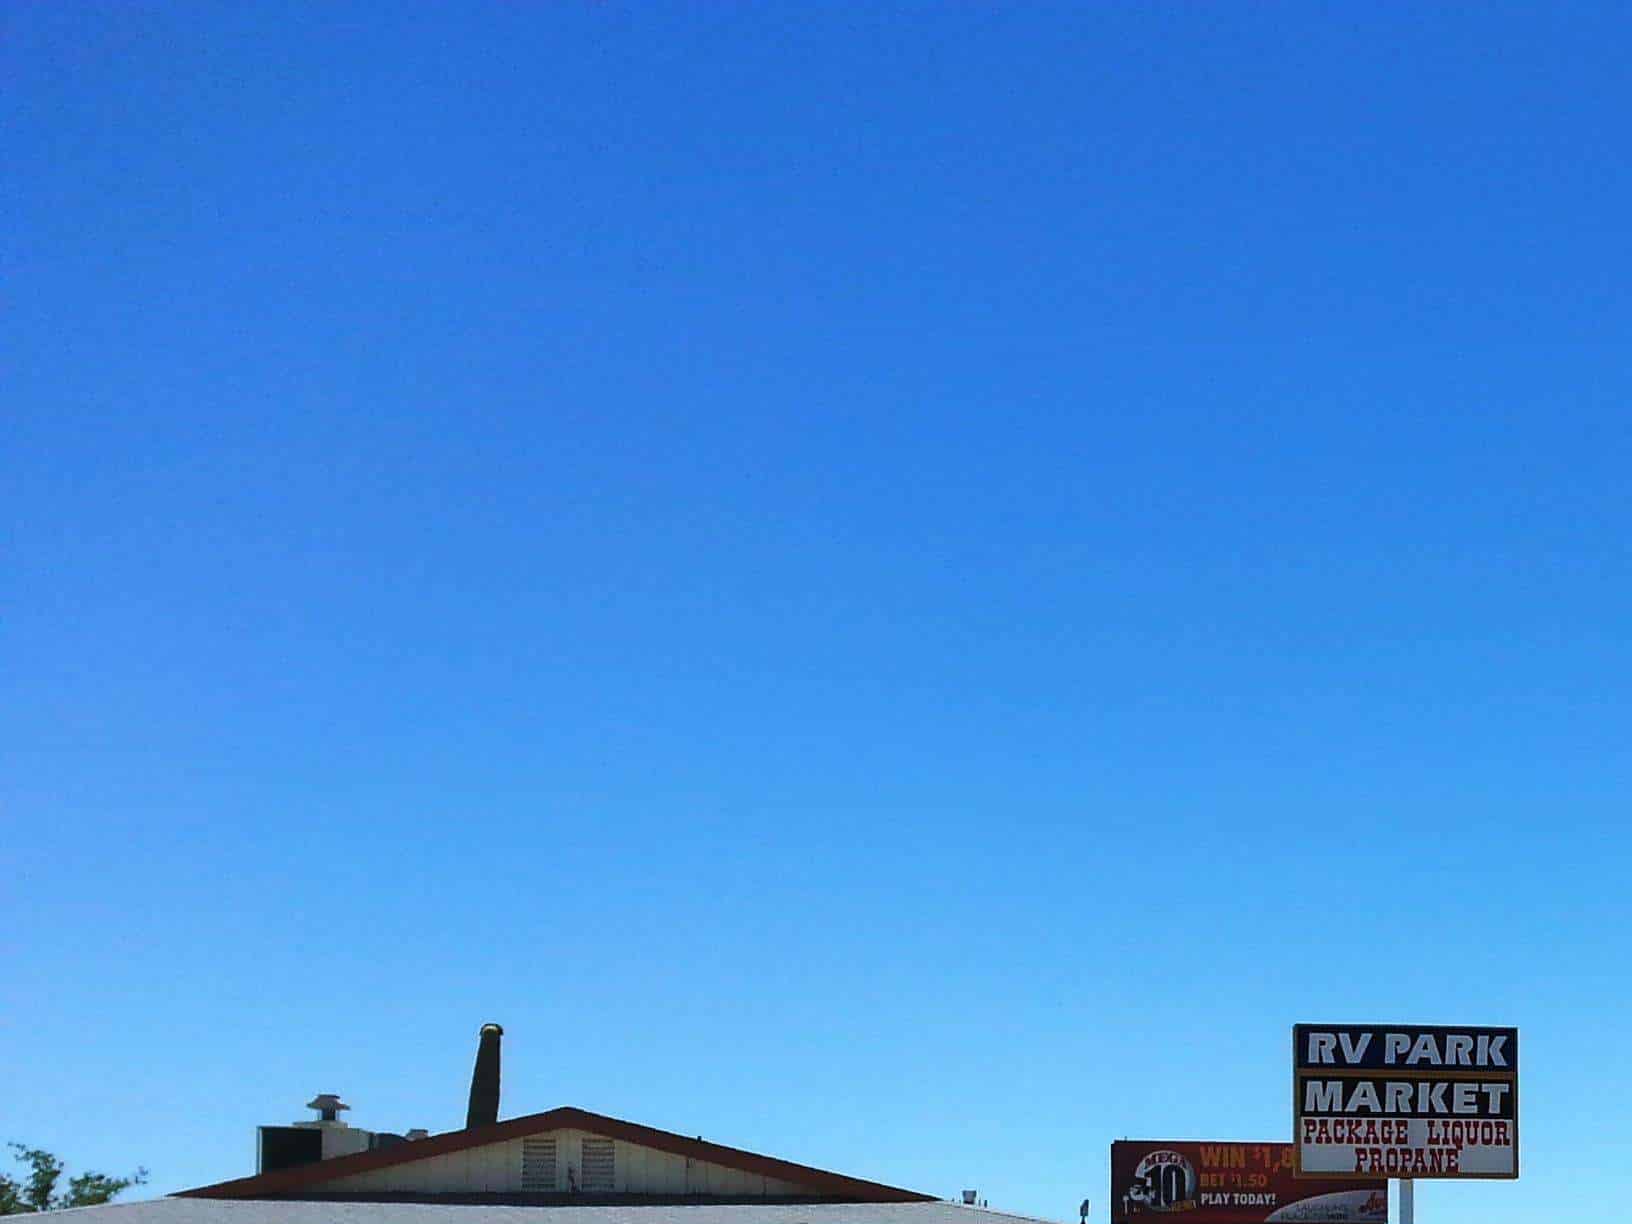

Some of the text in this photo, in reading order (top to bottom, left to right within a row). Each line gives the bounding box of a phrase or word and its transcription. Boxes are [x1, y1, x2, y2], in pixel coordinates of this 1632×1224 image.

[1307, 1032, 1508, 1066] RV PARK
[1304, 1081, 1509, 1114] MARKET
[1303, 1119, 1510, 1150] PACKAGE LIQUOR
[1200, 1145, 1246, 1168] WIN
[1354, 1148, 1460, 1173] PROPANE
[1200, 1192, 1229, 1206] PLAY
[1232, 1192, 1276, 1206] TODAY!
